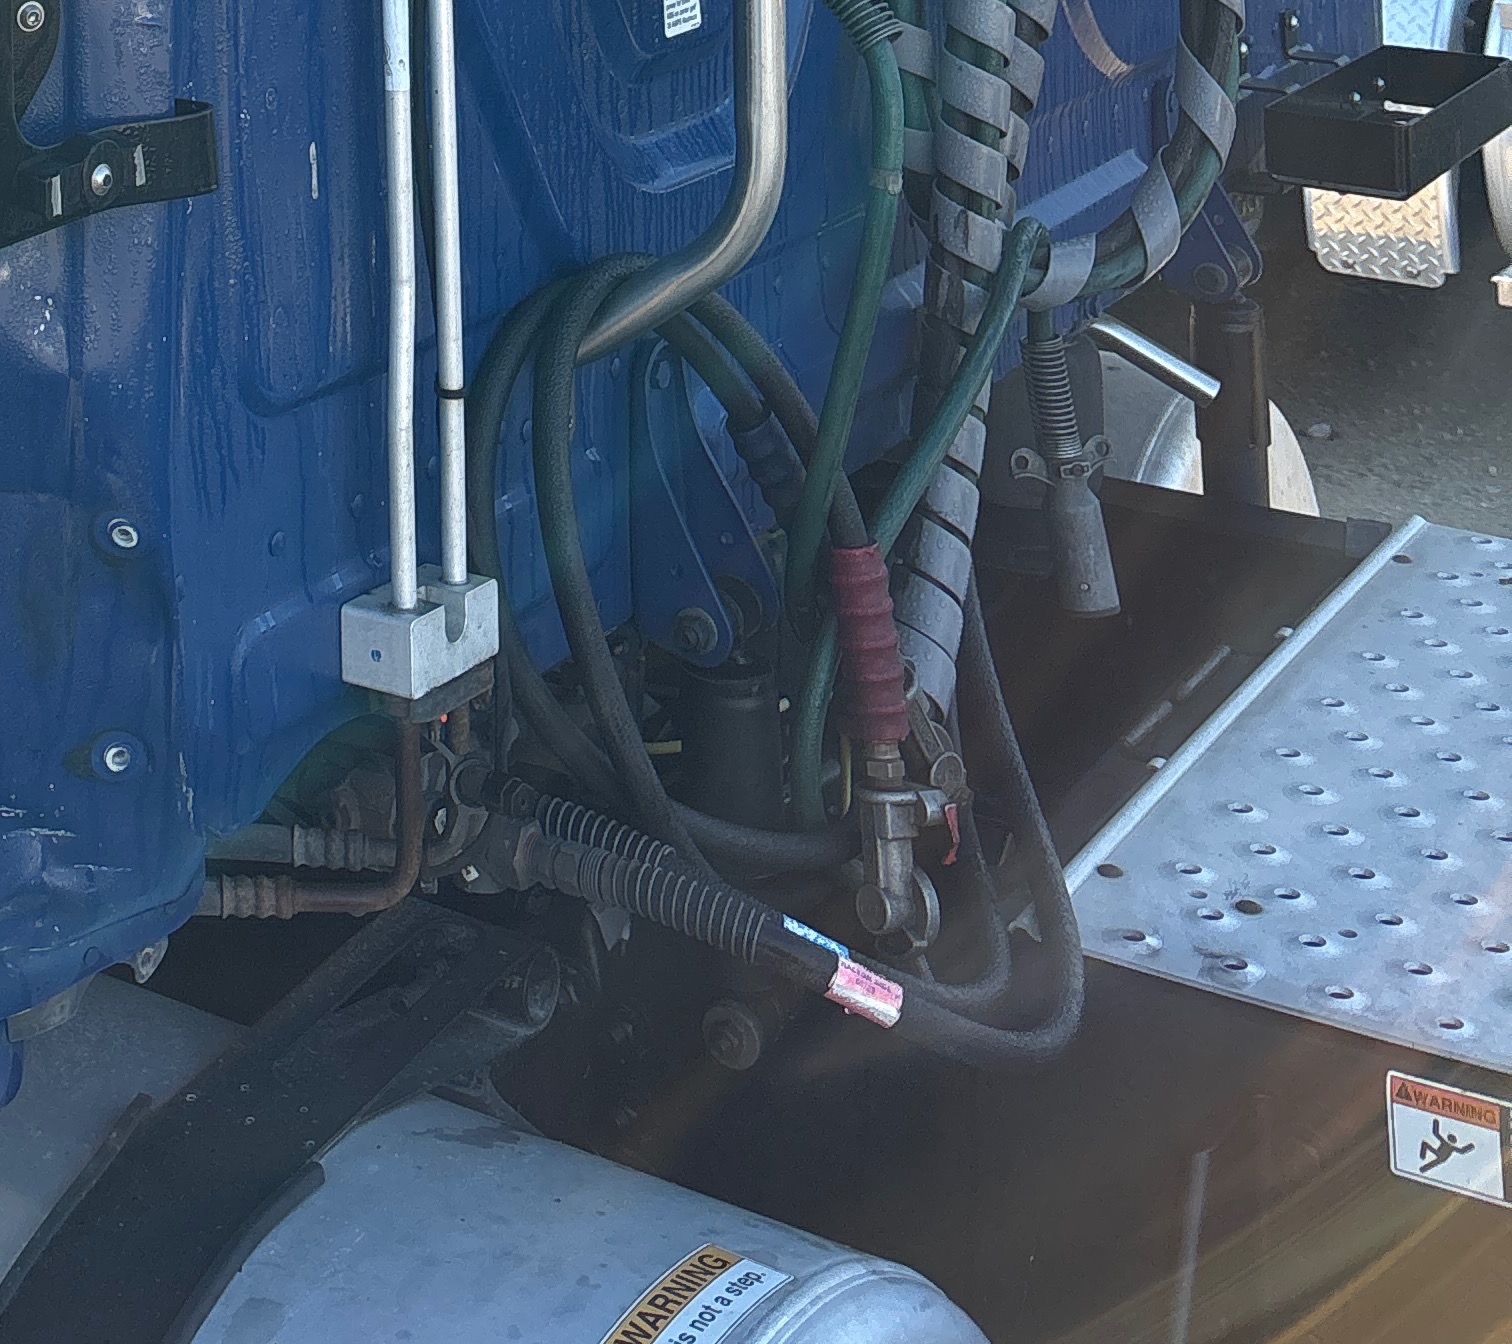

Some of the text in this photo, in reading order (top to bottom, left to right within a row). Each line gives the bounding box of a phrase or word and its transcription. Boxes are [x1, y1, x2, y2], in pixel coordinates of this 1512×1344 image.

[1412, 1087, 1497, 1124] WARNING
[613, 1253, 730, 1344] WARNING
[689, 1303, 723, 1333] not
[714, 1295, 733, 1308] a
[725, 1270, 768, 1297] step.
